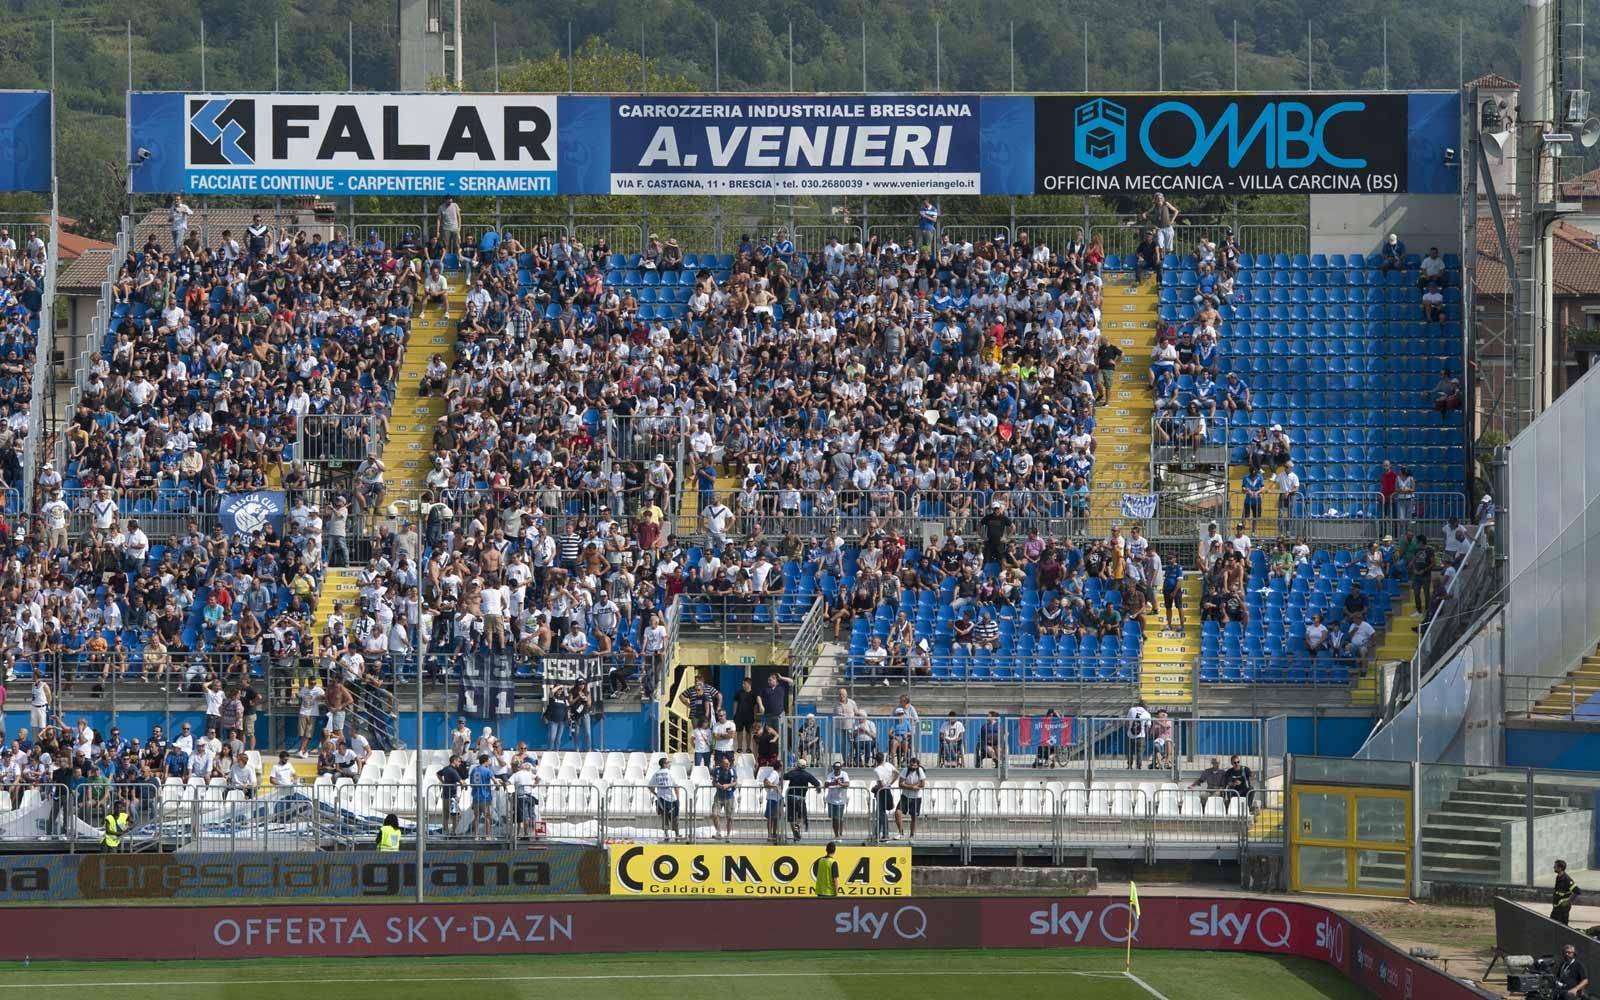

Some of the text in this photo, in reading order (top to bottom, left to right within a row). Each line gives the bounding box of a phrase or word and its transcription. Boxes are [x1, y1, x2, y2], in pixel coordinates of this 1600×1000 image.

[618, 103, 972, 119] CARROZZERIA INDUSTRIALE BRESCIANA
[271, 104, 552, 161] FALAR
[638, 125, 953, 167] A.VENIERI
[1138, 101, 1367, 170] OMBC
[190, 175, 257, 190] FACCIATE
[260, 175, 335, 190] CONTINUE
[347, 175, 447, 191] CARPENTERIE
[459, 176, 551, 191] SERRAMENTI
[616, 179, 975, 190] VIA F. CASTAGNA, 11 BRESCIA tel. 030.2680039 www.venieriangelo.it
[1043, 175, 1120, 190] OFFICINA
[1126, 175, 1223, 190] MECCANICA
[1239, 175, 1284, 190] VILLA
[1289, 175, 1362, 190] CARCINA
[1366, 173, 1399, 193] (BS)
[616, 845, 904, 892] COSMOAS
[649, 884, 903, 895] Caldaie a CONDENAZIONE
[213, 913, 573, 946] OFFERTA SKY-DAZN
[835, 905, 927, 940] sky Q
[1029, 903, 1140, 943] sky Q
[1189, 904, 1291, 947] sky Q
[1315, 916, 1335, 959] sky
